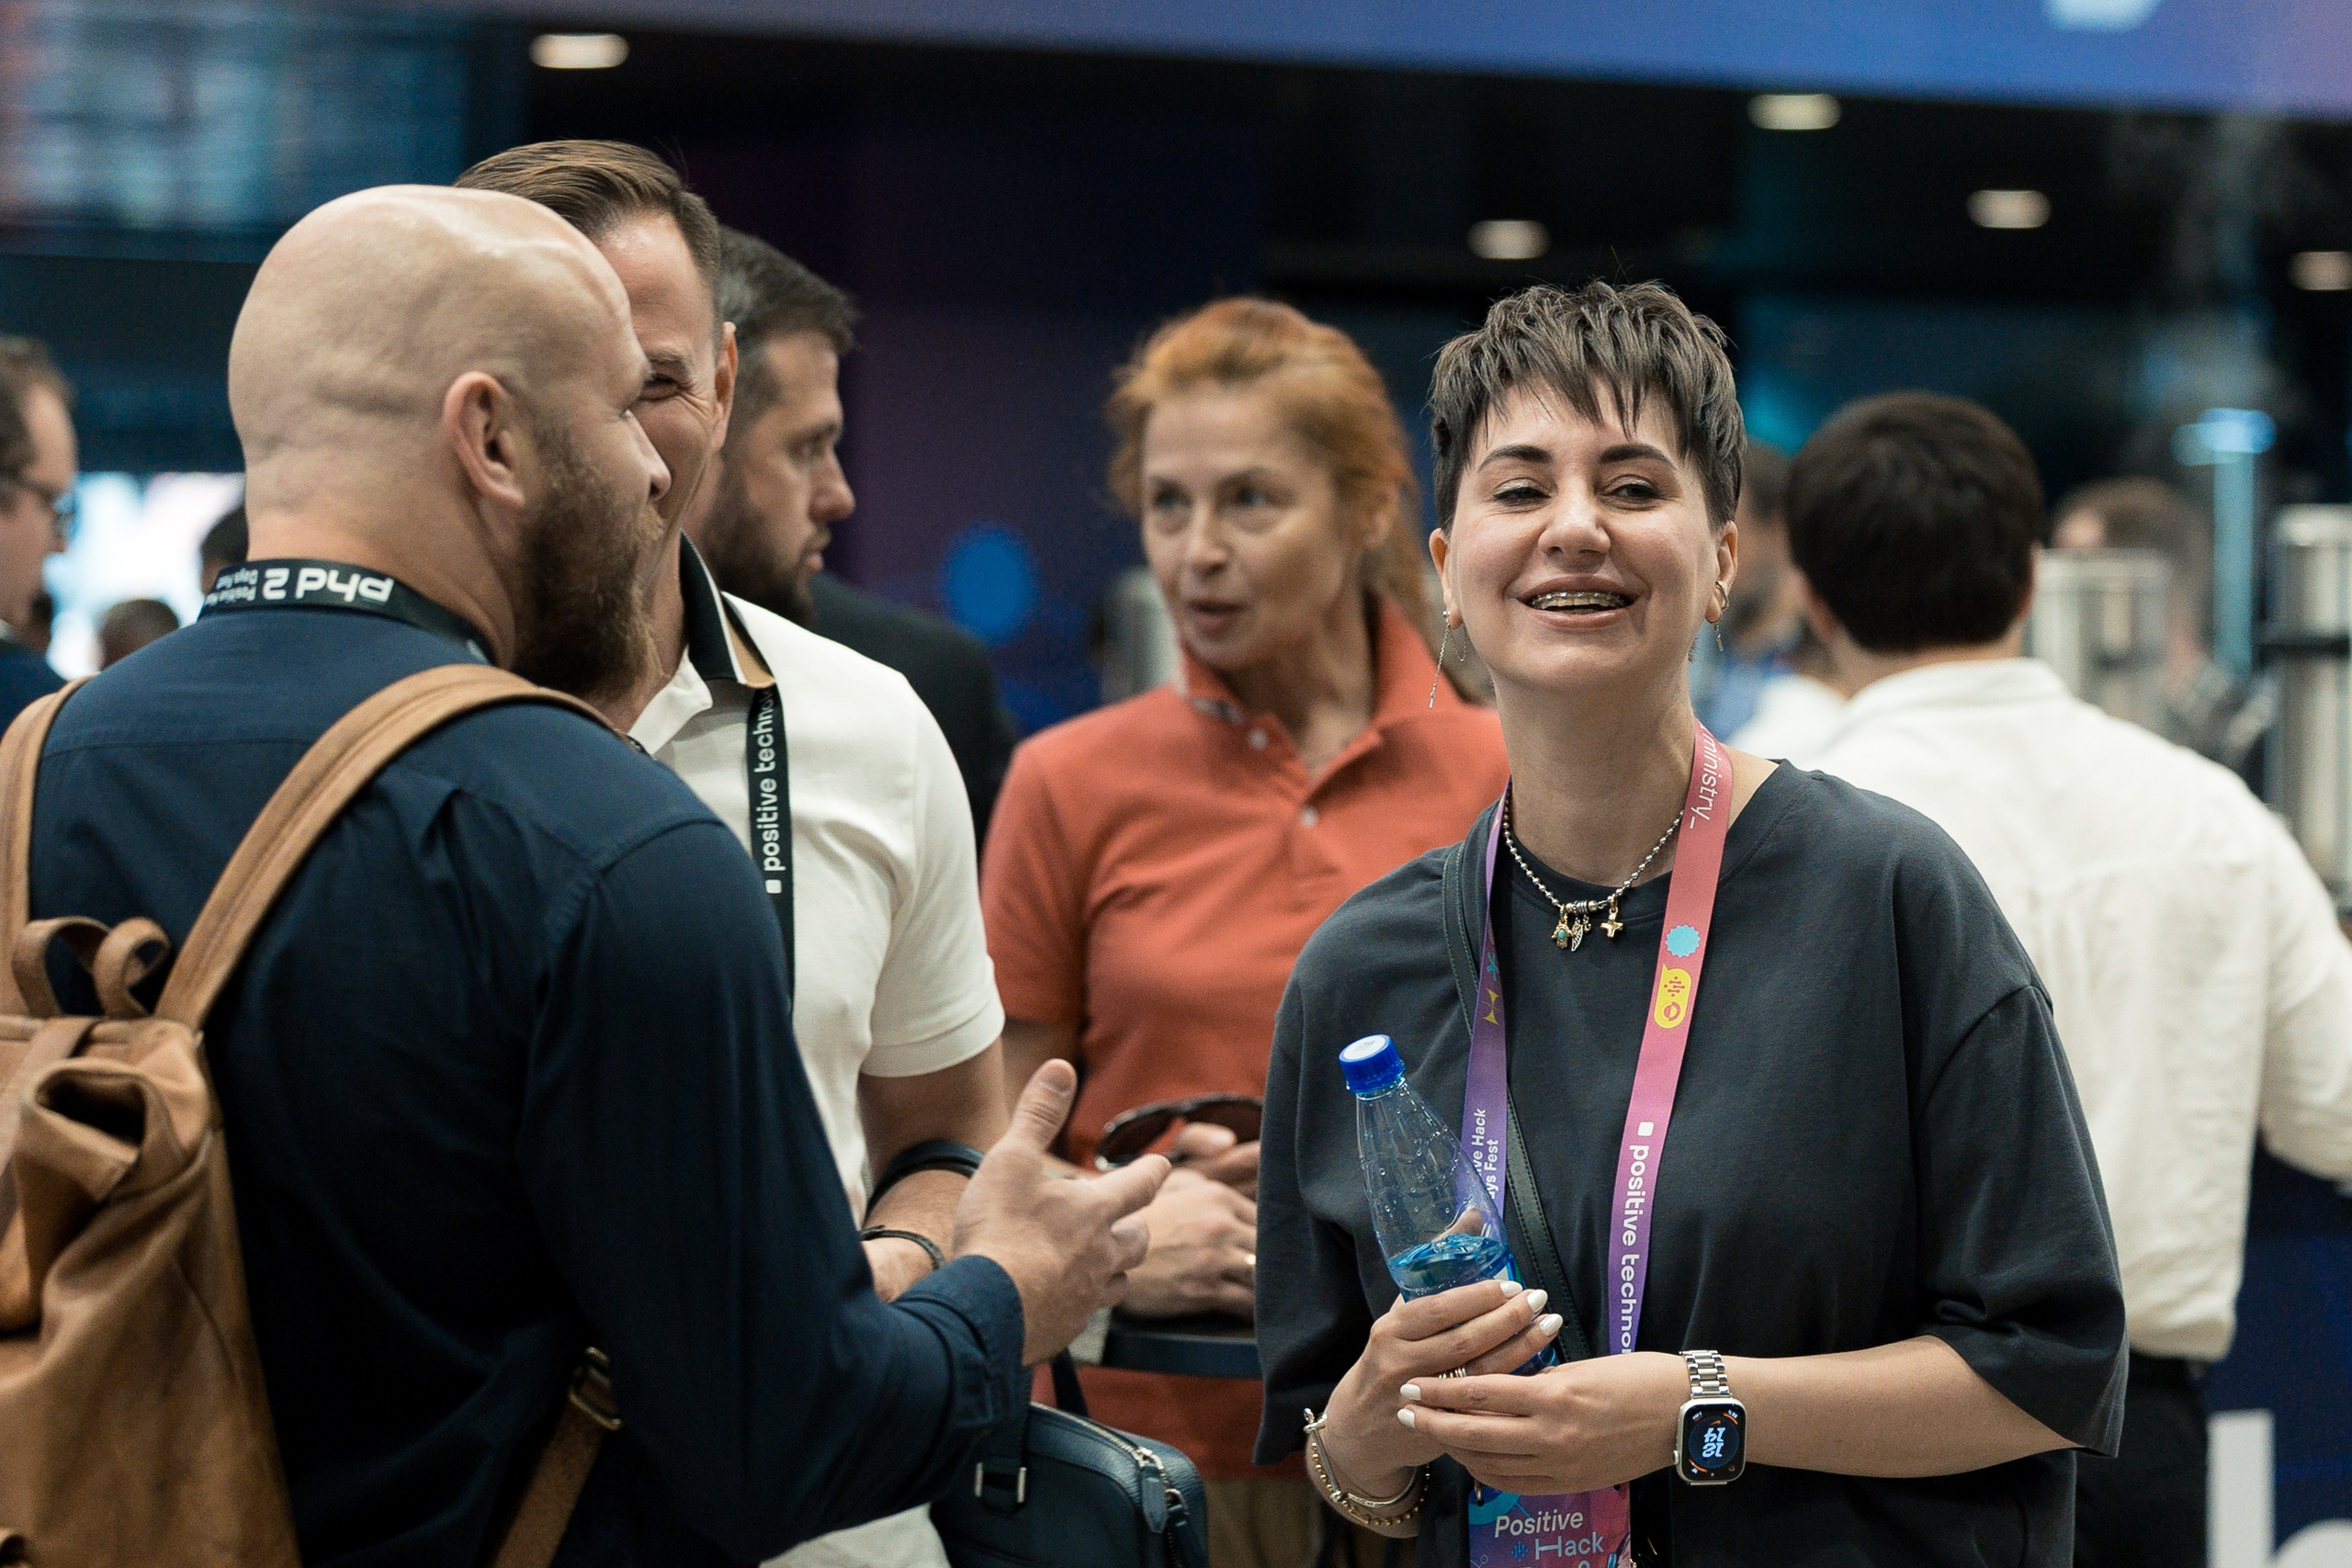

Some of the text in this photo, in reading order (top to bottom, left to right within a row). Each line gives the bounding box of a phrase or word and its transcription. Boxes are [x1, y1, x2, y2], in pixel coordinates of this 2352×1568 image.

[262, 567, 290, 601] 2
[295, 567, 395, 604] phd
[756, 777, 786, 872] positive
[1471, 1108, 1487, 1146] Hack
[1484, 1138, 1499, 1170] Fest
[1622, 1145, 1650, 1247] positive
[1702, 1442, 1724, 1458] 12
[1703, 1427, 1726, 1443] 14
[1494, 1508, 1584, 1539] Positive
[1534, 1531, 1605, 1561] Hack
